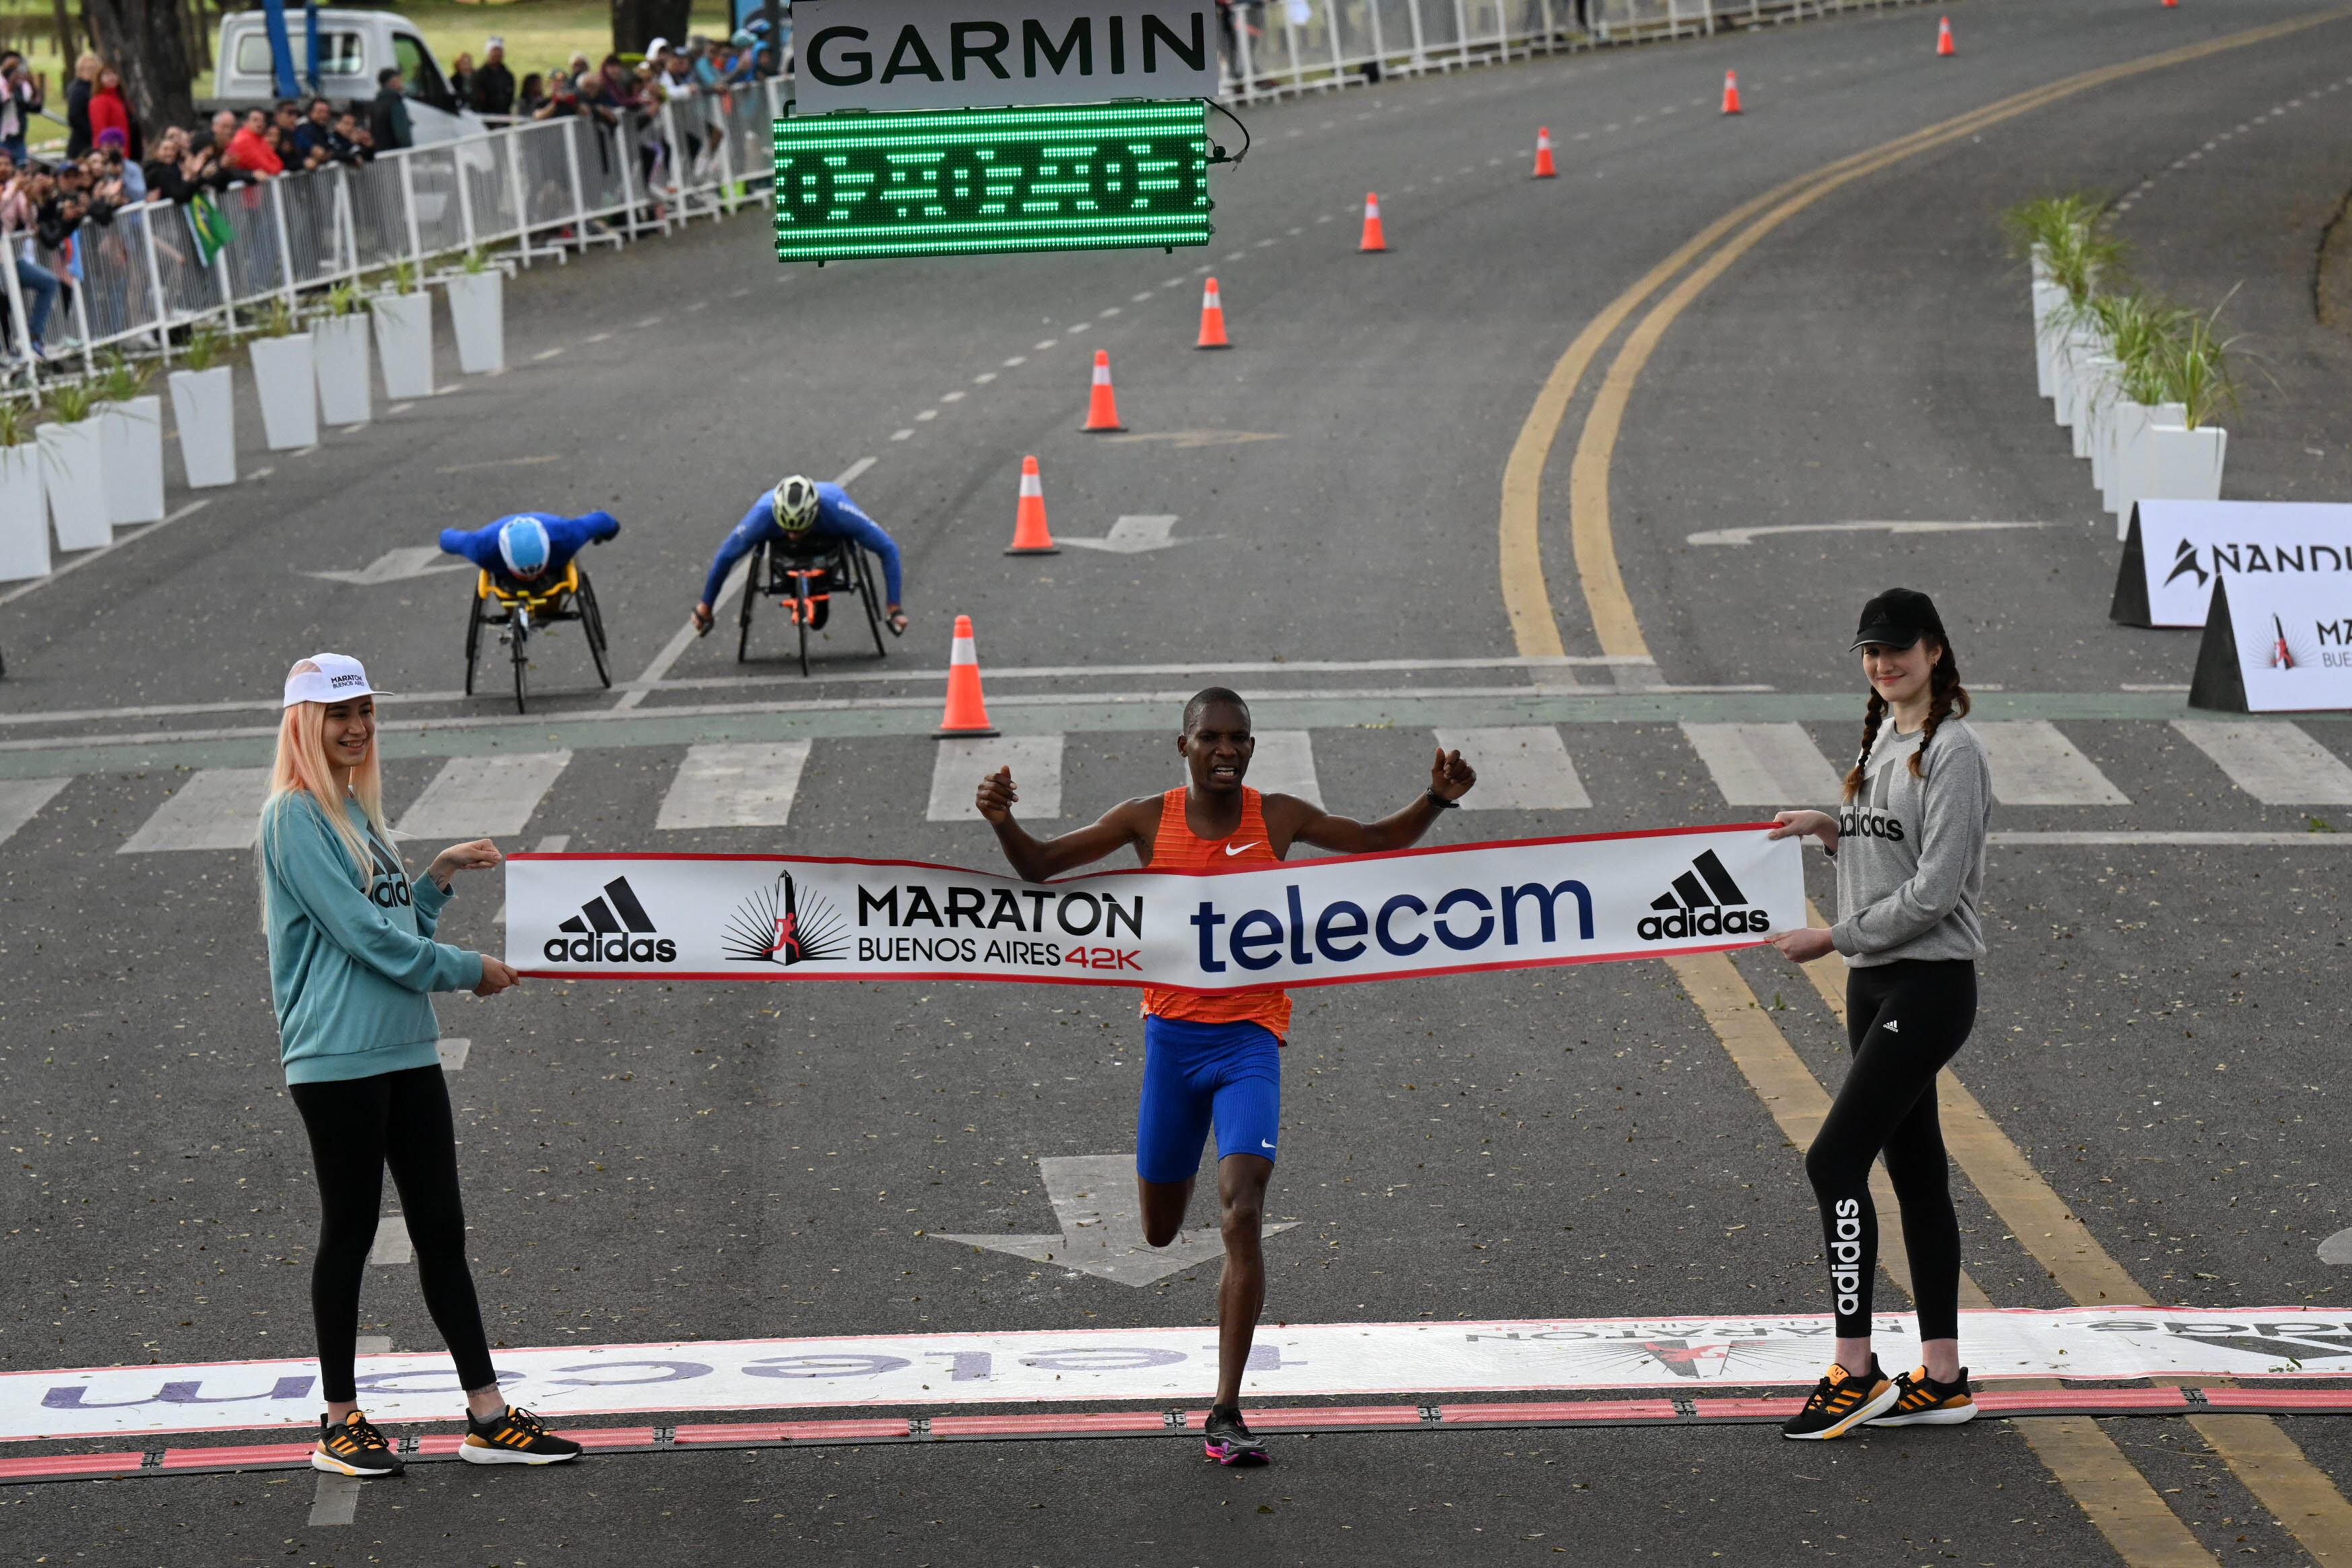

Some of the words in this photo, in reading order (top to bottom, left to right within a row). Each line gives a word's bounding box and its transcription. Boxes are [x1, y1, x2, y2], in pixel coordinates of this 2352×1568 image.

[806, 12, 1206, 86] GARMIN
[2212, 543, 2352, 573] ÑAND
[857, 884, 1144, 940] MARATON
[1189, 880, 1594, 973] telecom
[1637, 905, 1770, 940] adidas
[544, 932, 677, 962] adidas
[859, 938, 977, 962] BUENOS
[984, 940, 1061, 967] AIRES
[1064, 946, 1143, 971] 42K
[1831, 1198, 1861, 1315] adidas
[1724, 1319, 1899, 1327] BNOS
